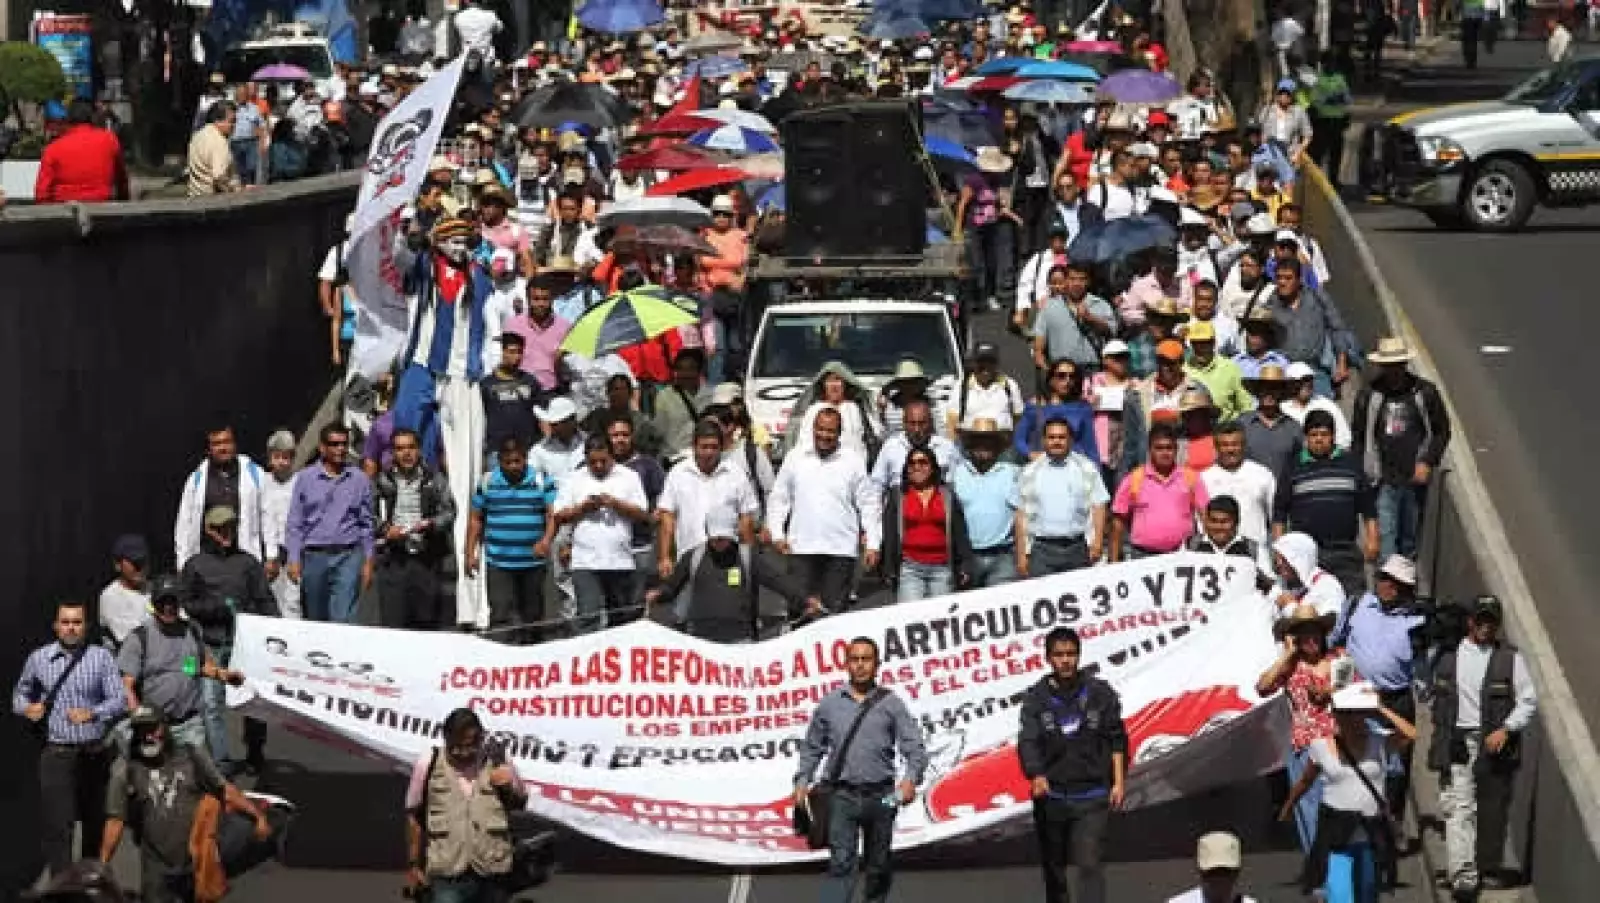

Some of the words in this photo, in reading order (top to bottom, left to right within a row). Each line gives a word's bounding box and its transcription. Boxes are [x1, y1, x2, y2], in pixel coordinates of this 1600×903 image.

[440, 661, 562, 692] ¡CONTRA
[570, 646, 622, 686] LAS
[792, 649, 810, 678] A
[814, 638, 849, 674] LO
[884, 592, 1081, 662] ARTÍCULOS
[1140, 571, 1165, 607] Y
[467, 693, 749, 718] CONSTITUCIONALES
[756, 664, 915, 711] IMPUAS
[922, 647, 981, 677] POR
[989, 641, 1023, 660] LA
[626, 722, 682, 737] LOS
[690, 710, 810, 737] EMPRES
[905, 681, 923, 699] Y
[931, 673, 965, 695] EL
[971, 653, 1042, 683] CLER
